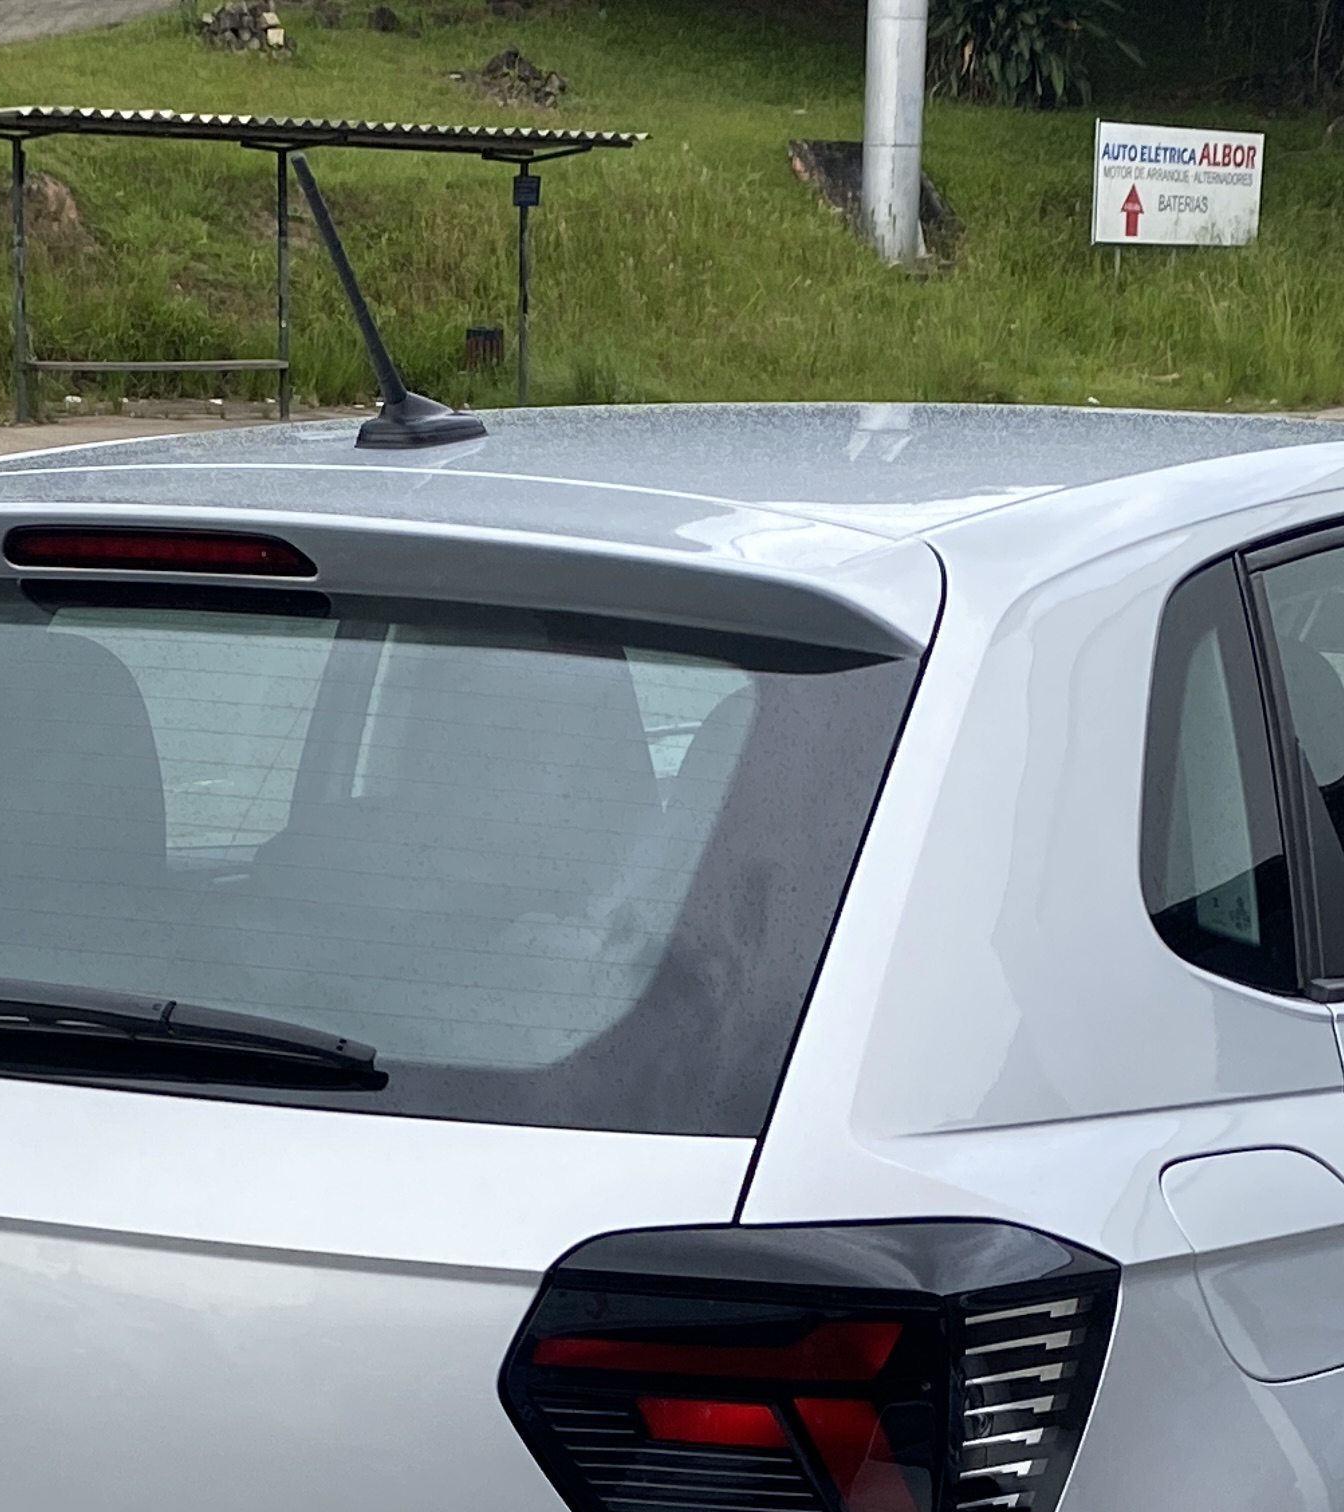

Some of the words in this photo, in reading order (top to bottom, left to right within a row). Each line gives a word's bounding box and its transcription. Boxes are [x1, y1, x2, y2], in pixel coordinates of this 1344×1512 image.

[1102, 143, 1137, 161] AUTO
[1140, 142, 1197, 165] ELÉTRICA
[1199, 143, 1257, 169] ALBOR
[1103, 165, 1132, 179] MOTOR
[1134, 166, 1145, 180] DE
[1146, 167, 1190, 183] ARRANQUE
[1158, 194, 1208, 213] BATERIAS
